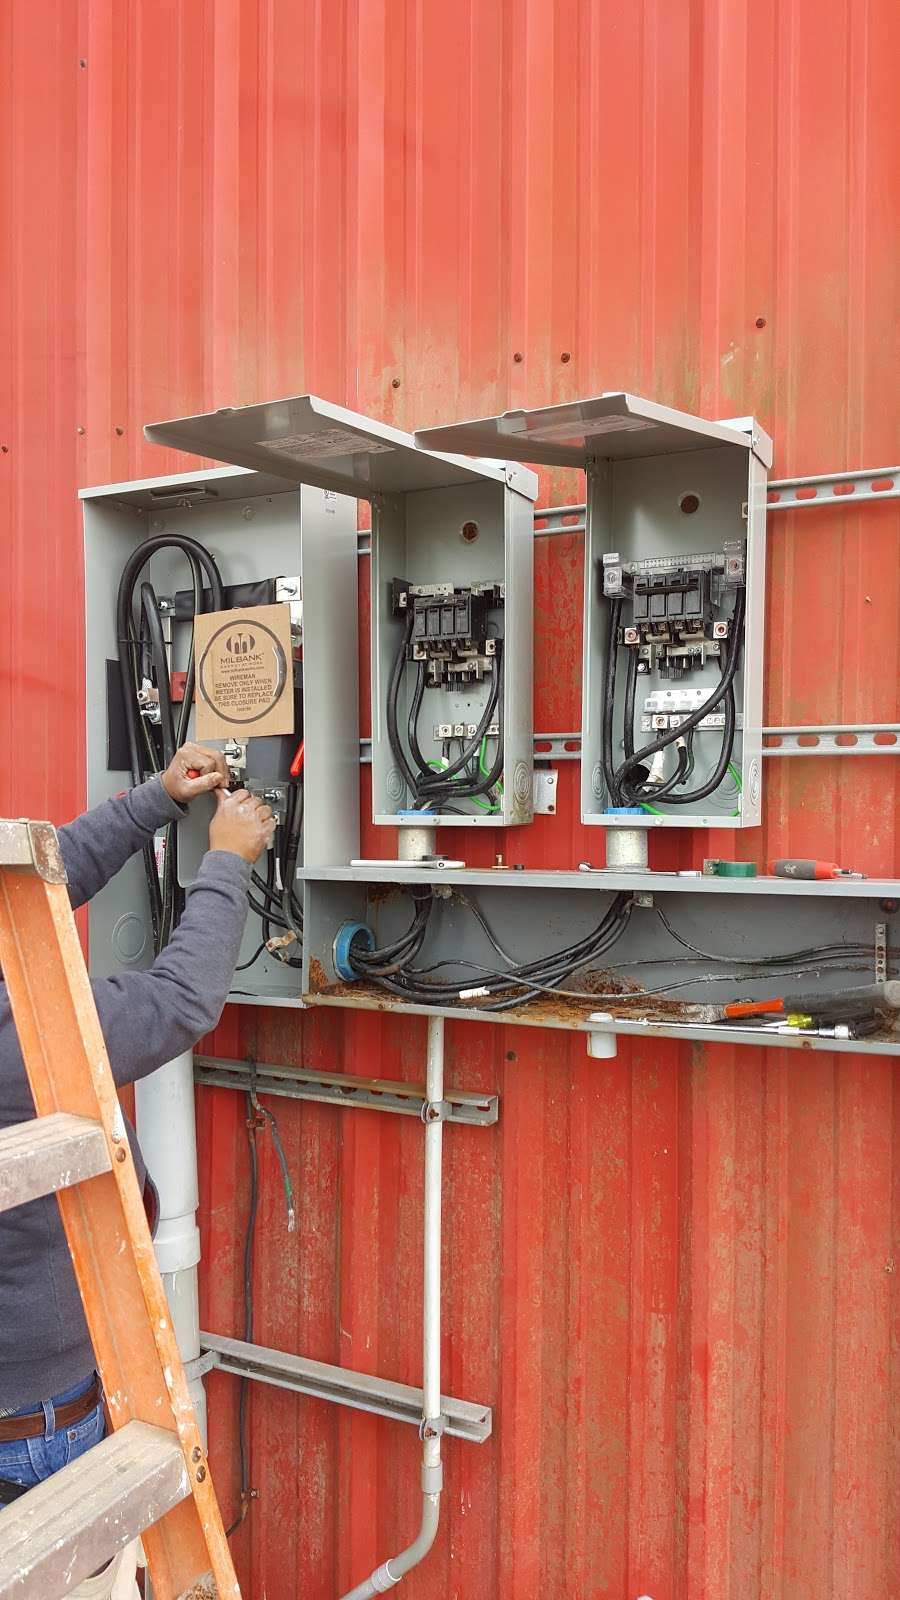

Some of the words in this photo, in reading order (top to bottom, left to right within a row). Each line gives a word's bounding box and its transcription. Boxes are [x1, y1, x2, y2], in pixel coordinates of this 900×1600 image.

[220, 654, 262, 664] MILBANK
[229, 673, 256, 681] WIREMAN
[241, 684, 272, 693] INSTALLED
[222, 693, 238, 701] SURE
[247, 690, 273, 699] REPLACE
[231, 698, 257, 706] CLOSURE
